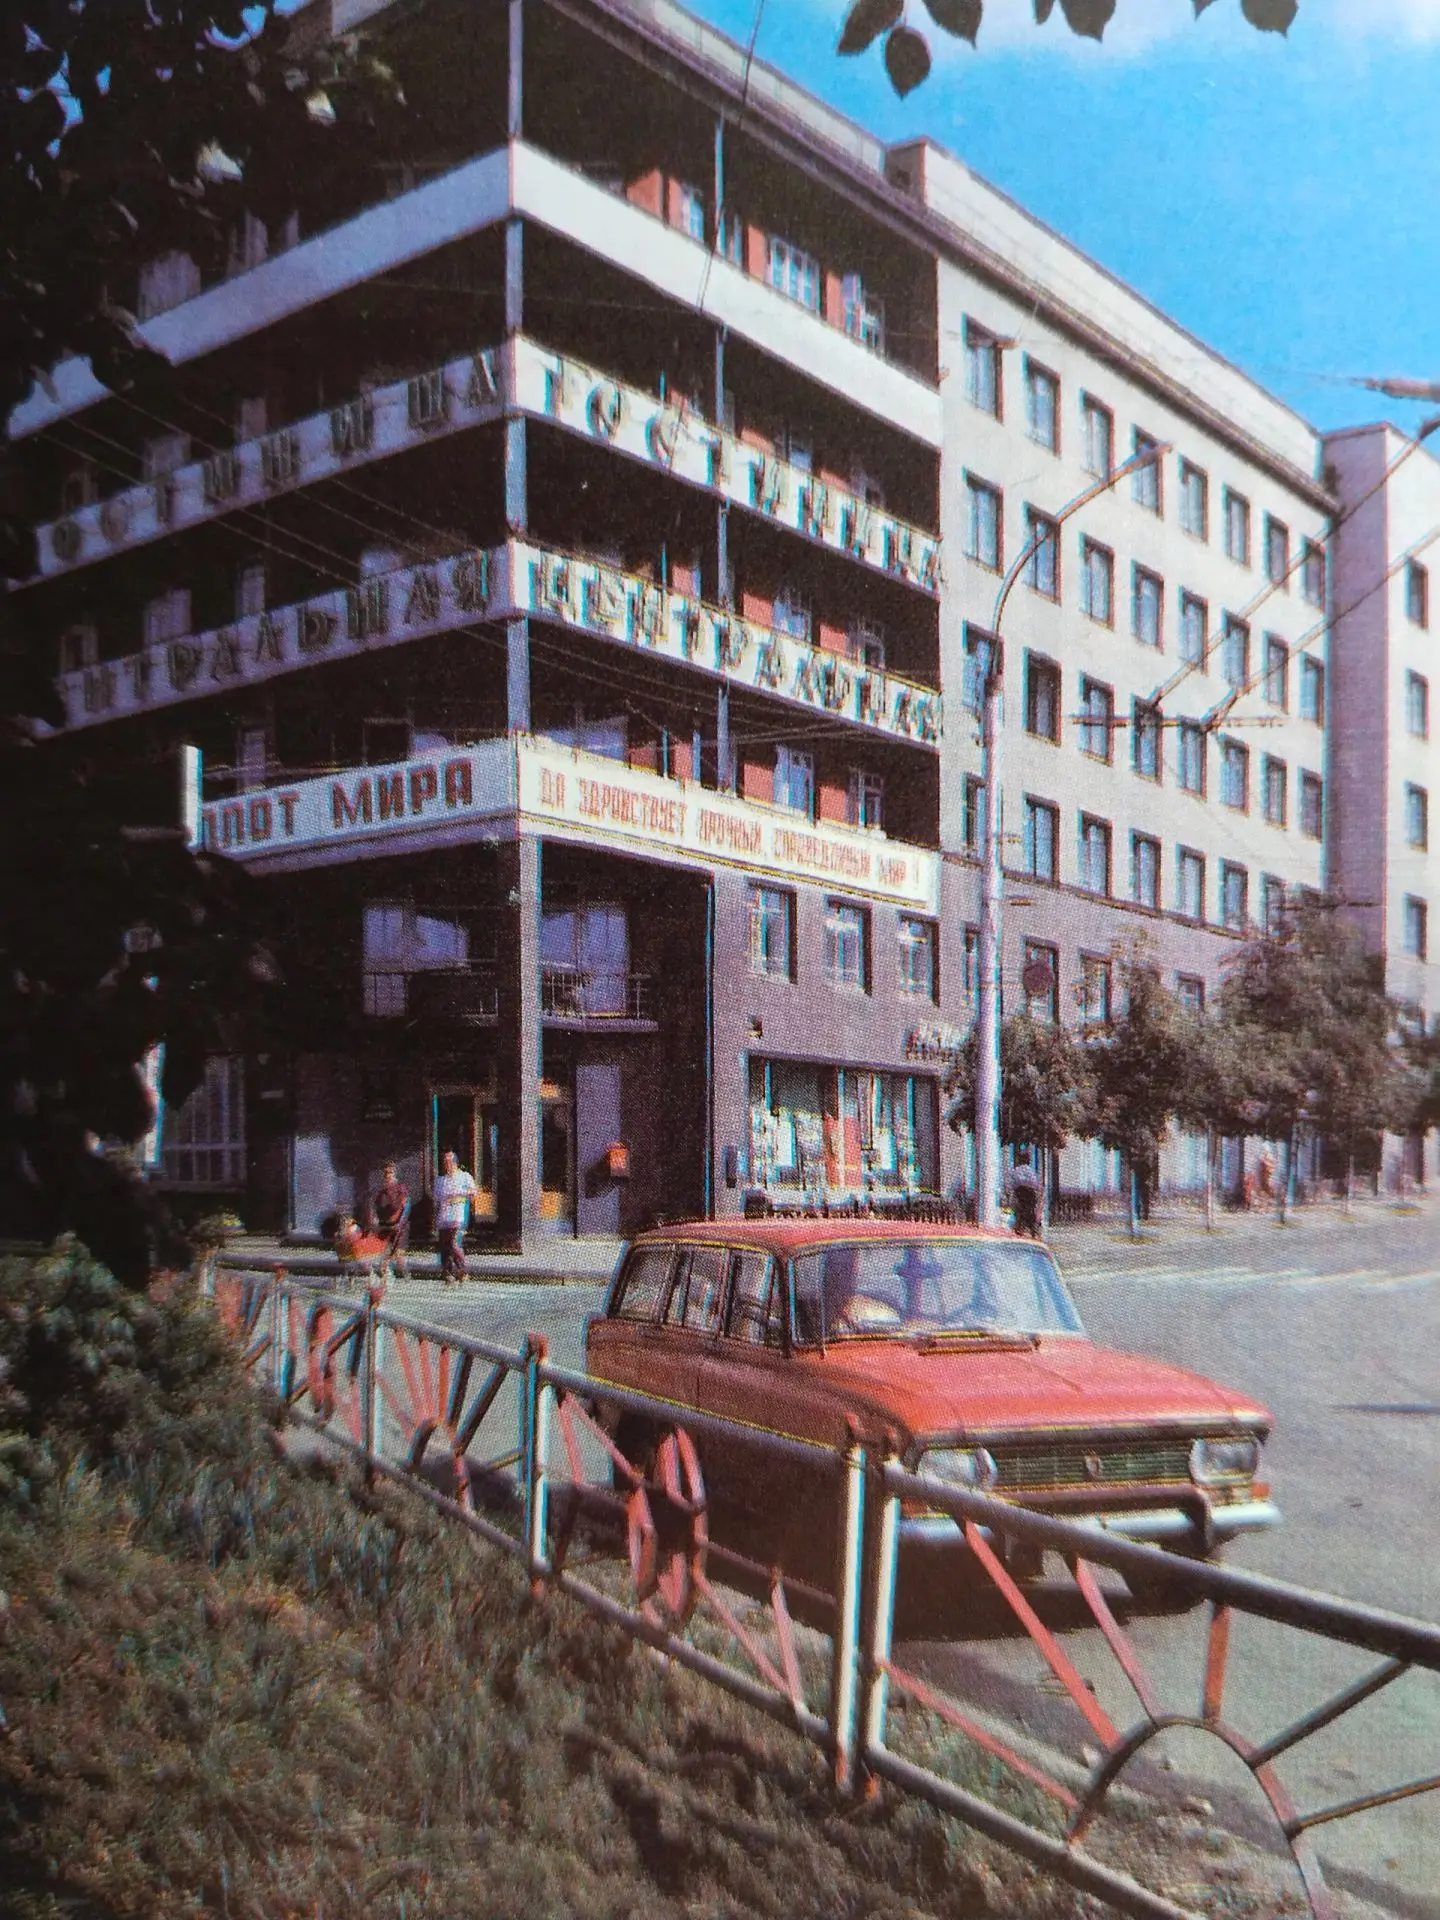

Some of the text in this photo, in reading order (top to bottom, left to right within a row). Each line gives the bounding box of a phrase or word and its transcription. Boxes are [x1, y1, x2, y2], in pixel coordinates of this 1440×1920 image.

[52, 348, 498, 561] ОСТИНИЦА
[83, 550, 492, 712] НТРАЛЬНАЯ
[331, 757, 474, 828] МИРА
[540, 767, 566, 808] ДА
[578, 778, 687, 837] ЗДРАВСТВУЕТ
